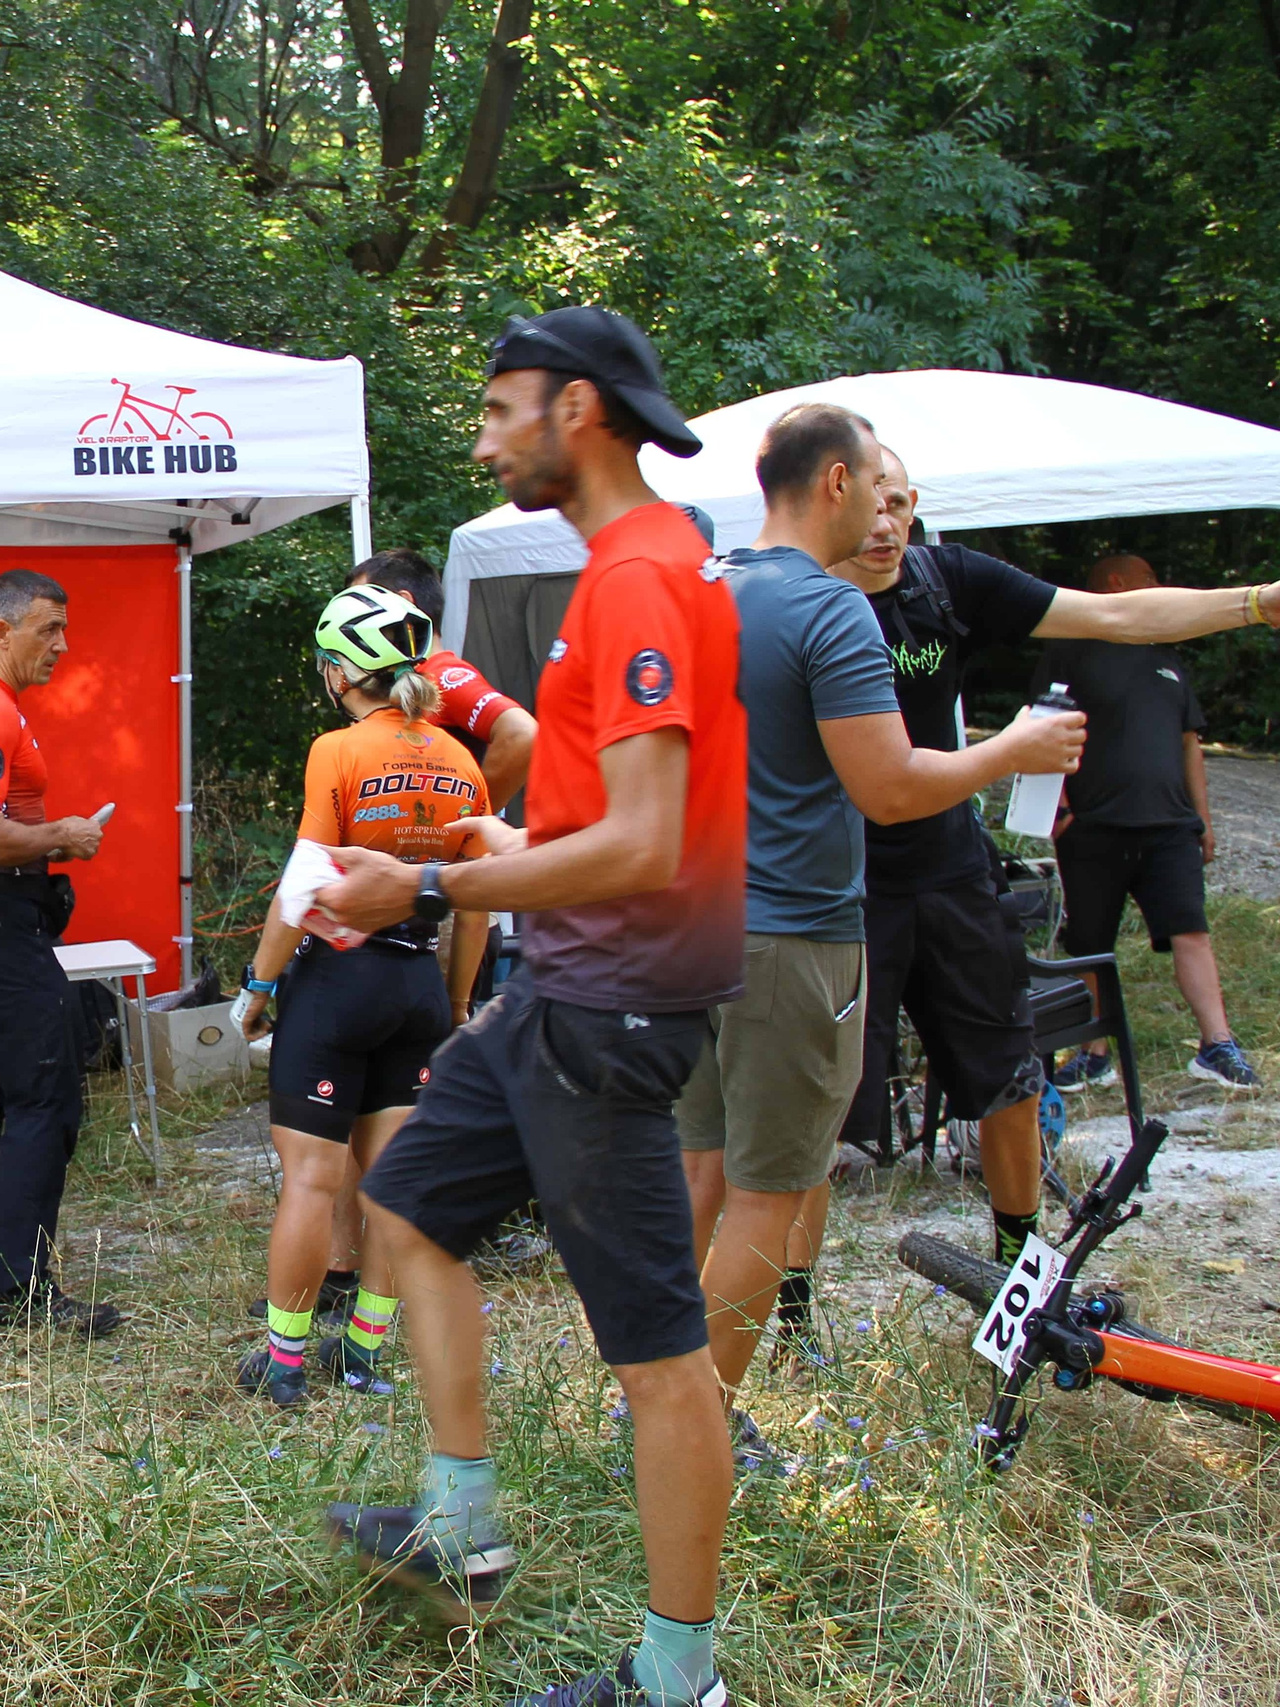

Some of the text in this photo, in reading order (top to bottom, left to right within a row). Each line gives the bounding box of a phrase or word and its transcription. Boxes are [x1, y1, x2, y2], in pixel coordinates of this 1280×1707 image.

[73, 444, 238, 476] BIKE HUB
[382, 761, 457, 774] Горна Баня
[393, 826, 449, 836] HOT SPRINGS
[983, 1253, 1042, 1353] 102
